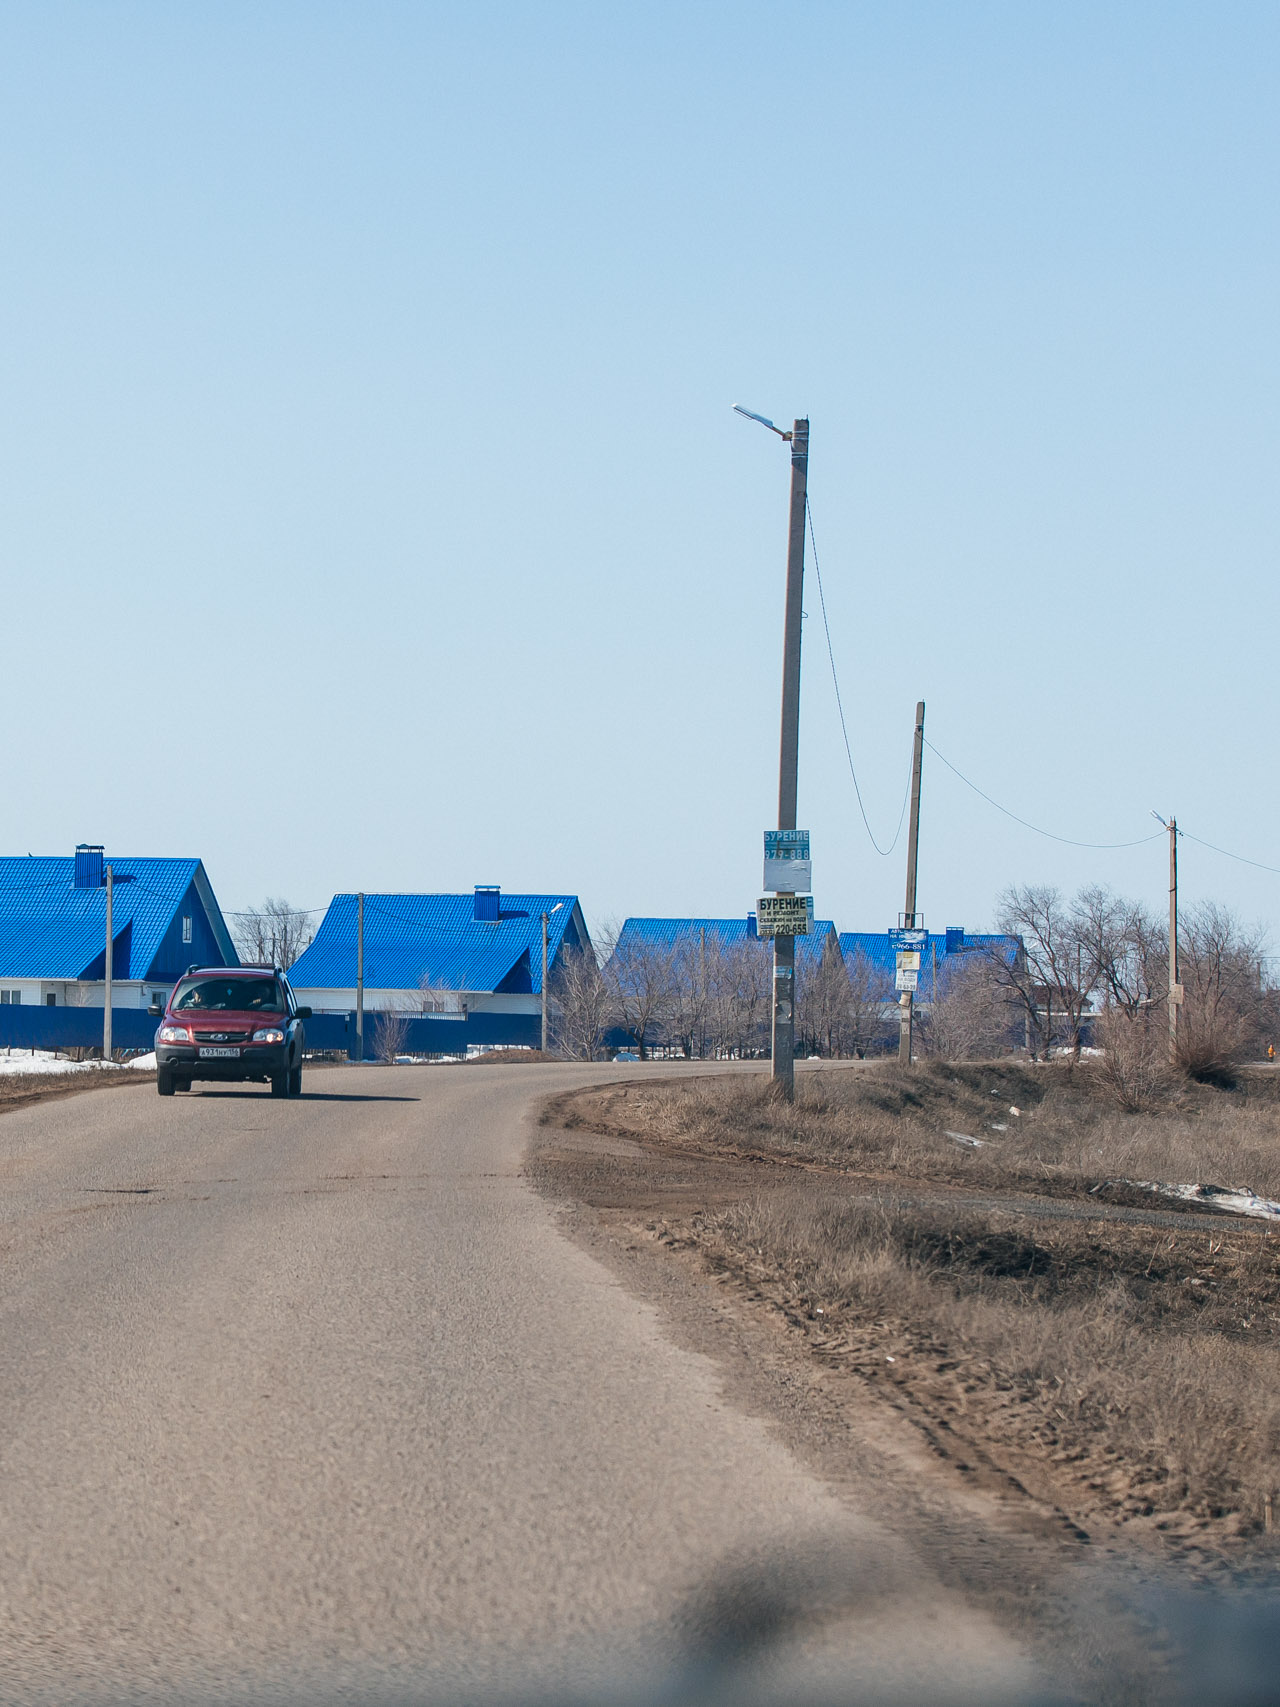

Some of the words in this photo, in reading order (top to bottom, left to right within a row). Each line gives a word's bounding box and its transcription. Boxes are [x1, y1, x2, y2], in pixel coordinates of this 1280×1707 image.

[764, 831, 809, 841] БУРЕНИЕ
[764, 849, 809, 860] 979-888
[760, 898, 806, 910] БУРЕНИЕ
[775, 924, 807, 934] 220-655
